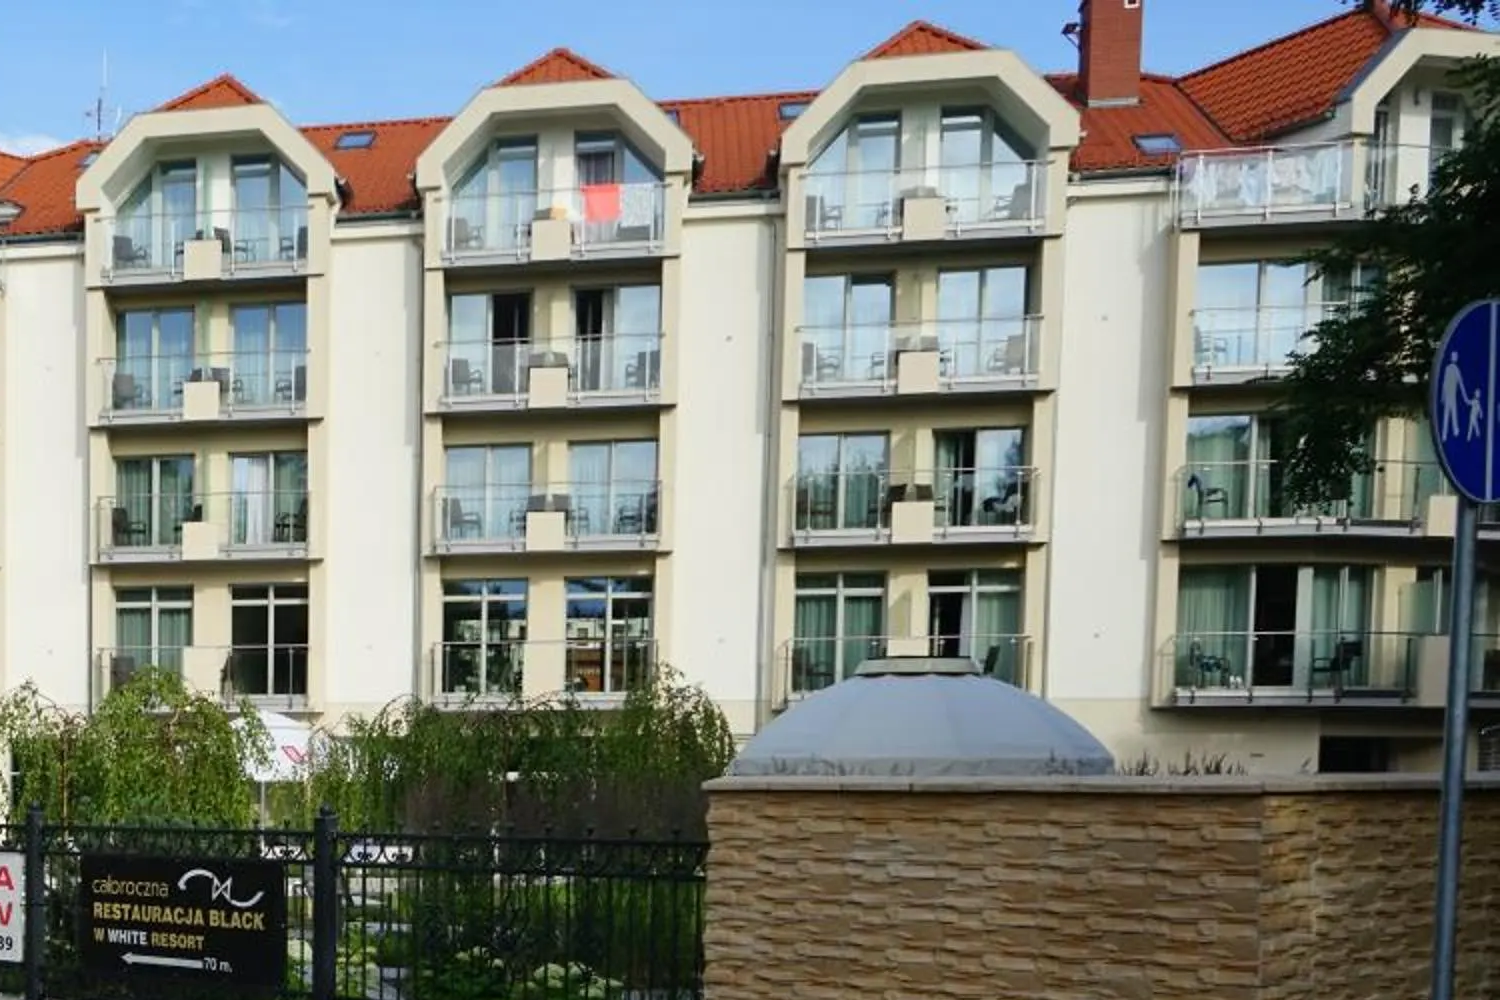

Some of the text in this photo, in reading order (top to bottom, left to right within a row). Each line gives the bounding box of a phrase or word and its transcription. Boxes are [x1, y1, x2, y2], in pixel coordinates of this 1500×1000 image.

[92, 874, 169, 897] całoroczna
[93, 902, 265, 930] RESTAURACJA BLACK
[94, 928, 204, 950] W WHITE RESORT
[203, 957, 232, 973] 70 m.
